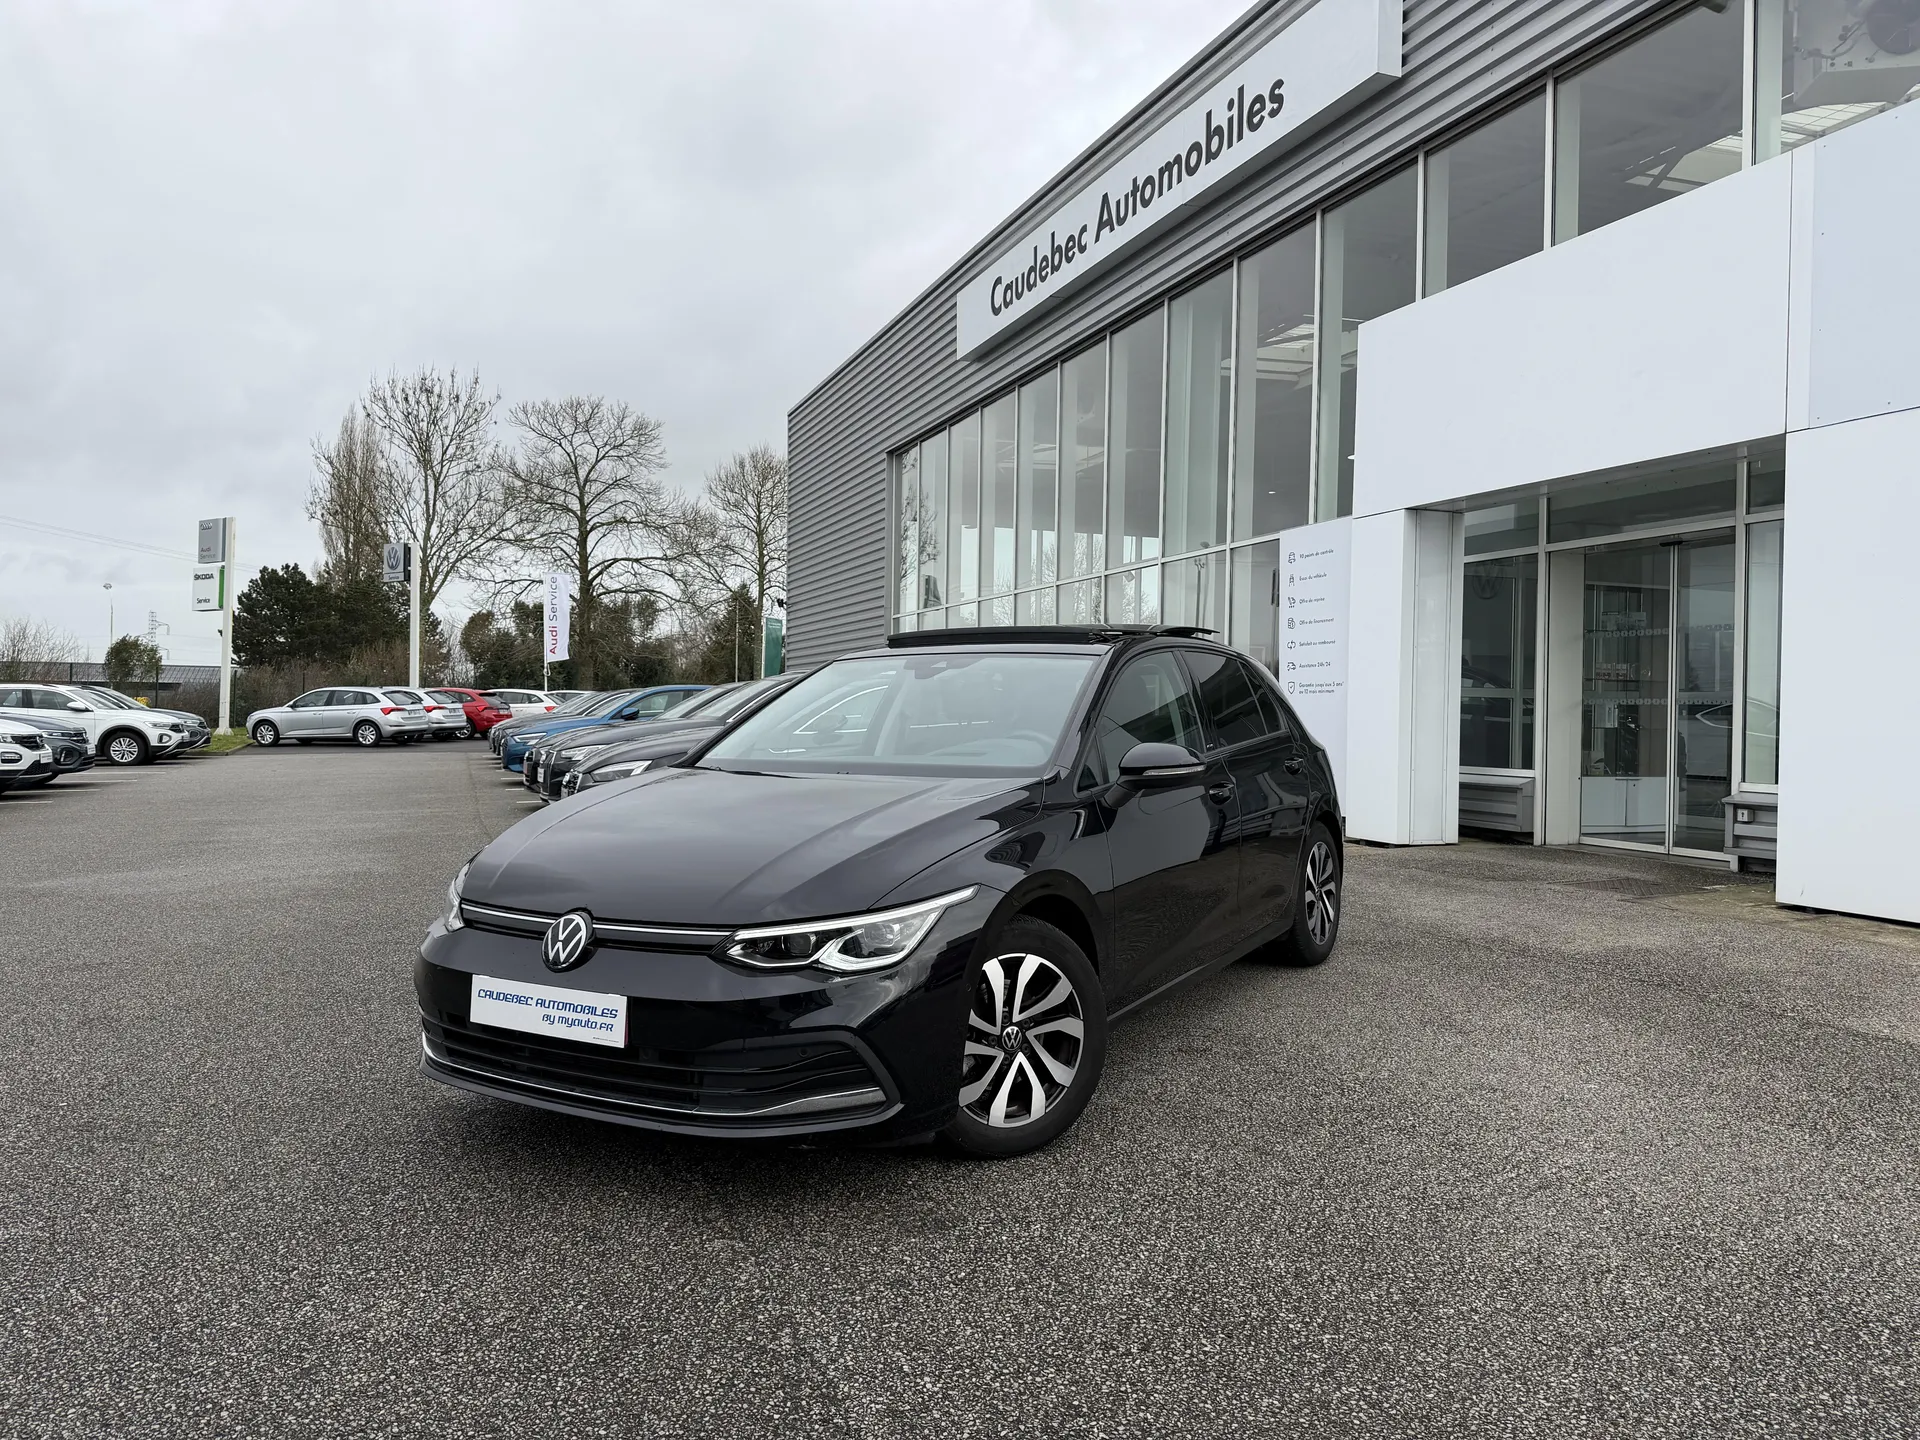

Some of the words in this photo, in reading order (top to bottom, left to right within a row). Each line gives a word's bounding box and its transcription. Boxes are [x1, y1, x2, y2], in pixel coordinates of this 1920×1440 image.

[990, 223, 1088, 316] Caudebec
[1094, 78, 1285, 244] Automobiles
[549, 576, 558, 622] Service
[549, 626, 558, 655] Audi
[477, 988, 534, 1007] CAUDEBEC
[535, 998, 618, 1018] AUTOMOBILES
